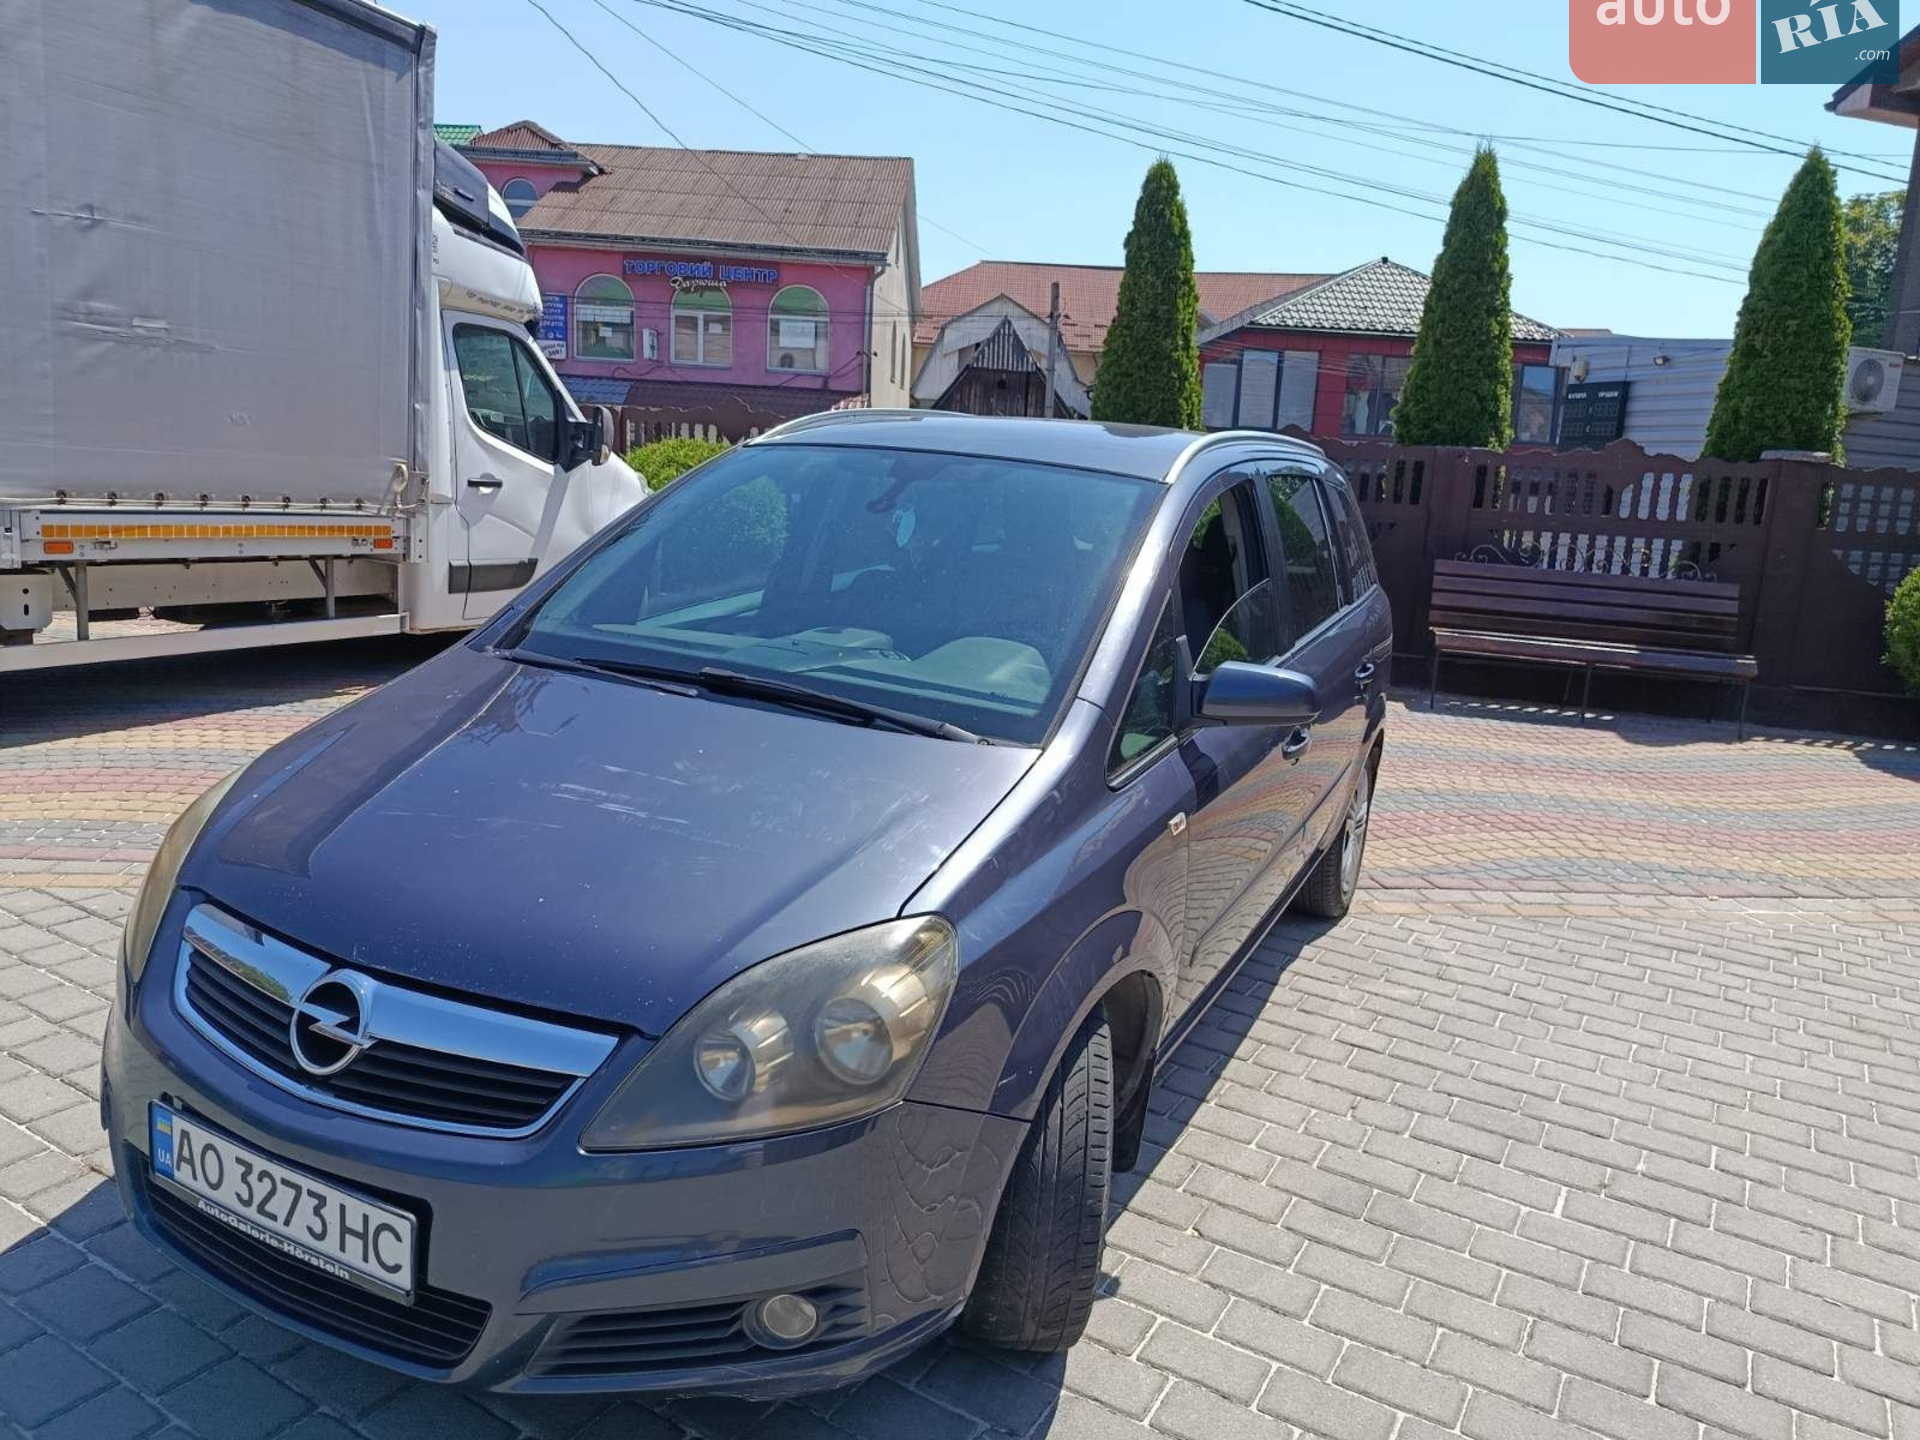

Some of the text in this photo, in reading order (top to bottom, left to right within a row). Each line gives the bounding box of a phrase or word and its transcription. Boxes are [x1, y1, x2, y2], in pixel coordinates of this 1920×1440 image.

[624, 259, 778, 284] ТОРГОВИЙ ЦЕНТР
[157, 1148, 172, 1167] UA
[234, 1156, 328, 1241] 3273
